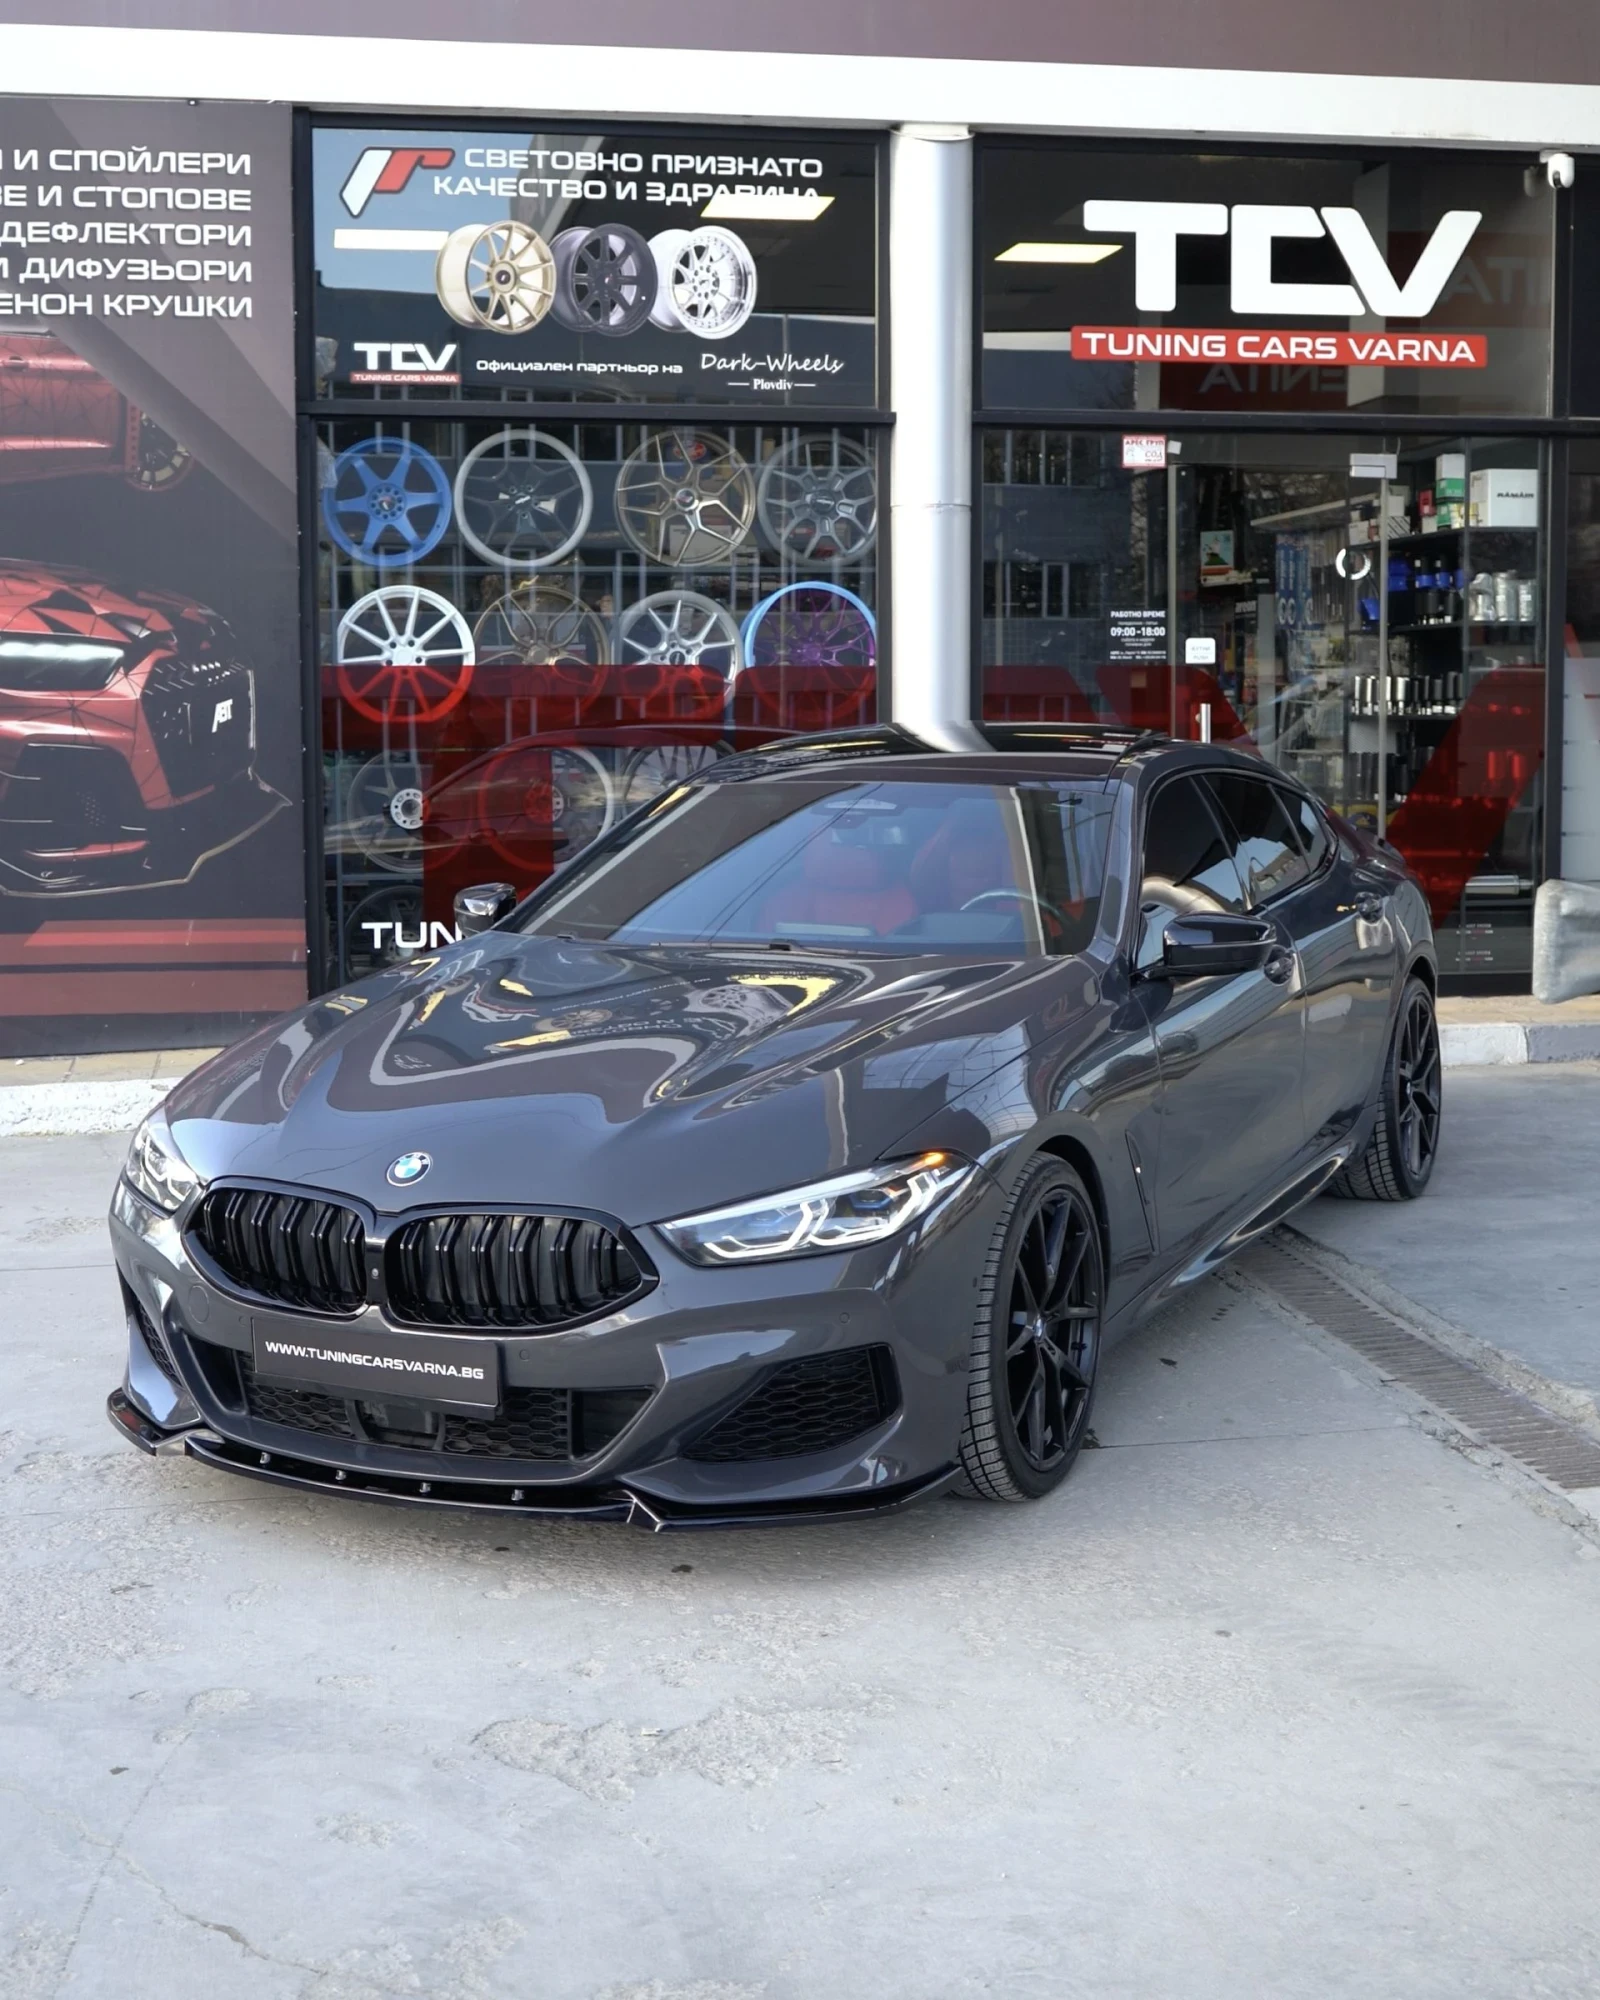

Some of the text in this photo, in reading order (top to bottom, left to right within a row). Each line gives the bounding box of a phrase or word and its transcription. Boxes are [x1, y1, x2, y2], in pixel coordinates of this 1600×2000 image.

[14, 150, 38, 170] И
[50, 146, 250, 175] СПОЙЛЕРИ
[465, 149, 822, 177] СВЕТОВНО ПРИЗНАТО
[0, 185, 251, 210] Е И СТОПОВЕ
[435, 176, 605, 198] КАЧЕСТВО
[616, 182, 636, 200] И
[0, 222, 251, 247] ДЕФЛЕКТОРИ
[19, 258, 251, 283] ДИФУЗЬОРИ
[1083, 199, 1482, 318] TCV
[104, 295, 252, 317] КРУШКИ
[354, 343, 456, 370] TCV
[1082, 333, 1475, 362] TUNING CARS VARNA
[476, 360, 682, 375] Официален партньор на
[700, 352, 844, 375] Dark-Wheels
[354, 374, 457, 383] TUNING CARS VARNA
[753, 377, 794, 391] Plovdiv
[1110, 610, 1142, 618] РАБОТНО
[265, 1341, 485, 1380] WWW.TUNINGCARSVARNA.BG
